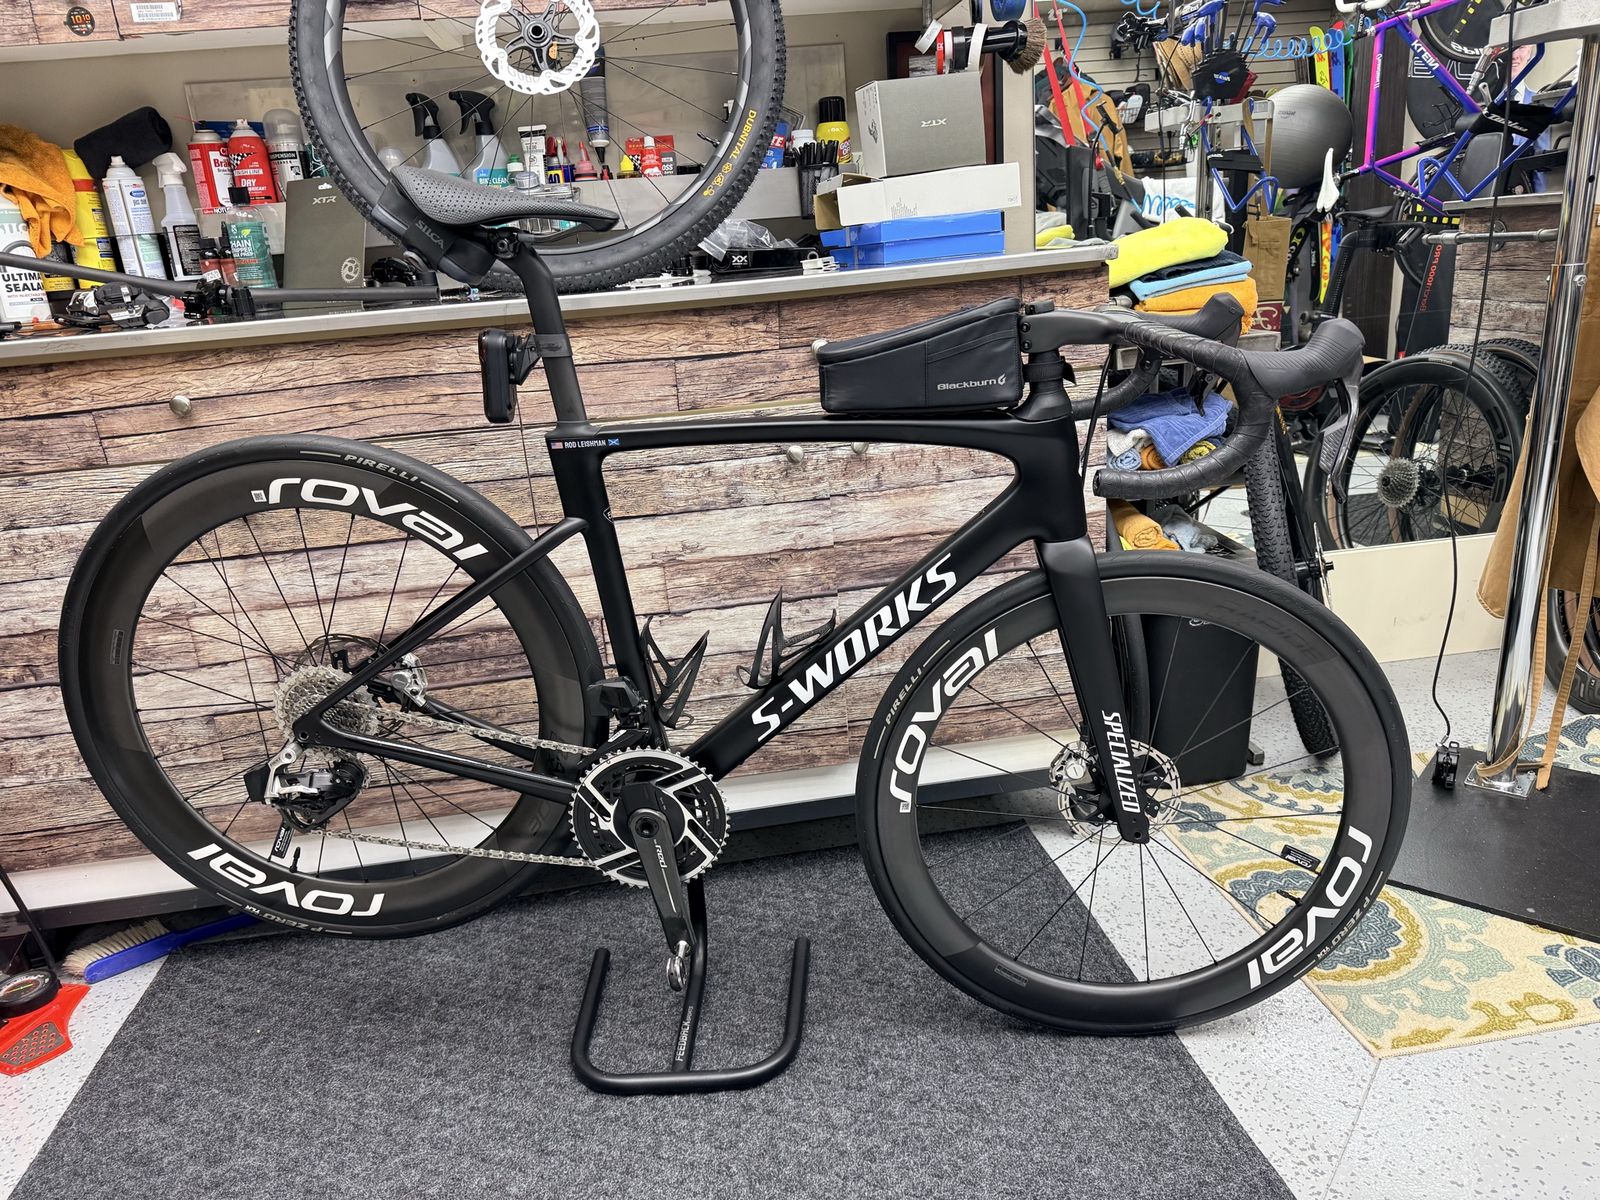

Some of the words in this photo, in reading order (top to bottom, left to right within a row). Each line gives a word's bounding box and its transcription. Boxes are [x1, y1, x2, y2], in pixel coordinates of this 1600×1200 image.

[729, 109, 758, 160] DUBNITAL
[241, 178, 257, 187] DRY
[312, 195, 337, 205] XTR
[415, 220, 445, 249] SILCA
[731, 254, 749, 263] XX
[937, 379, 997, 391] Blackburn
[564, 441, 577, 449] ROD
[577, 439, 607, 448] LEISHMAN
[344, 454, 419, 483] PIRELLI
[268, 477, 489, 561] roval
[751, 552, 957, 743] S-WORKS
[885, 667, 923, 726] PIRELLI
[889, 628, 999, 802] roval
[1101, 709, 1141, 814] SPECIALIZED
[186, 842, 386, 917] roval
[263, 912, 310, 930] ZERO
[1247, 825, 1373, 990] roval
[1331, 909, 1363, 945] ZERO
[675, 1020, 691, 1062] FEEDBACK
